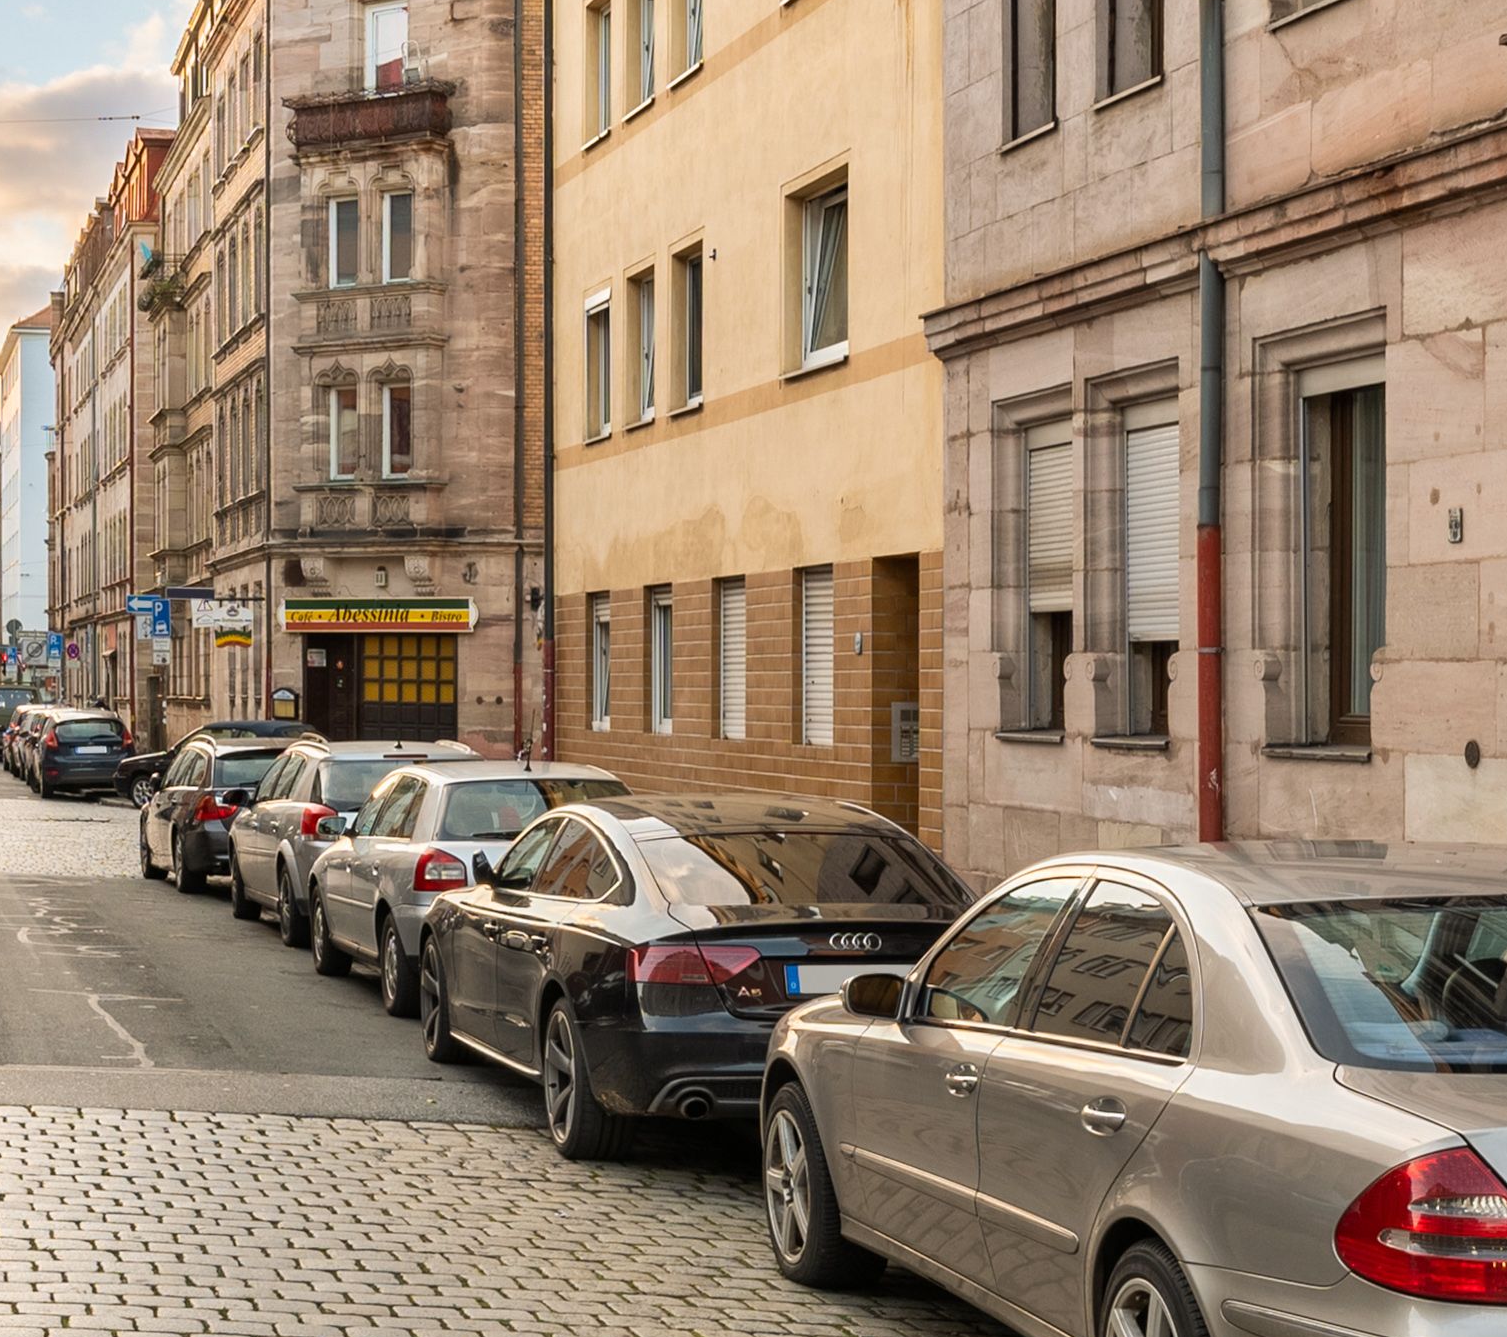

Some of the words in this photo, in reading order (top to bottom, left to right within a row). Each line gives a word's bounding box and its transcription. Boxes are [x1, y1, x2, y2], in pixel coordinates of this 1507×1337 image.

[154, 601, 163, 617] P
[290, 611, 314, 624] Café
[328, 604, 410, 623] Abessinia
[430, 610, 462, 622] Bistro
